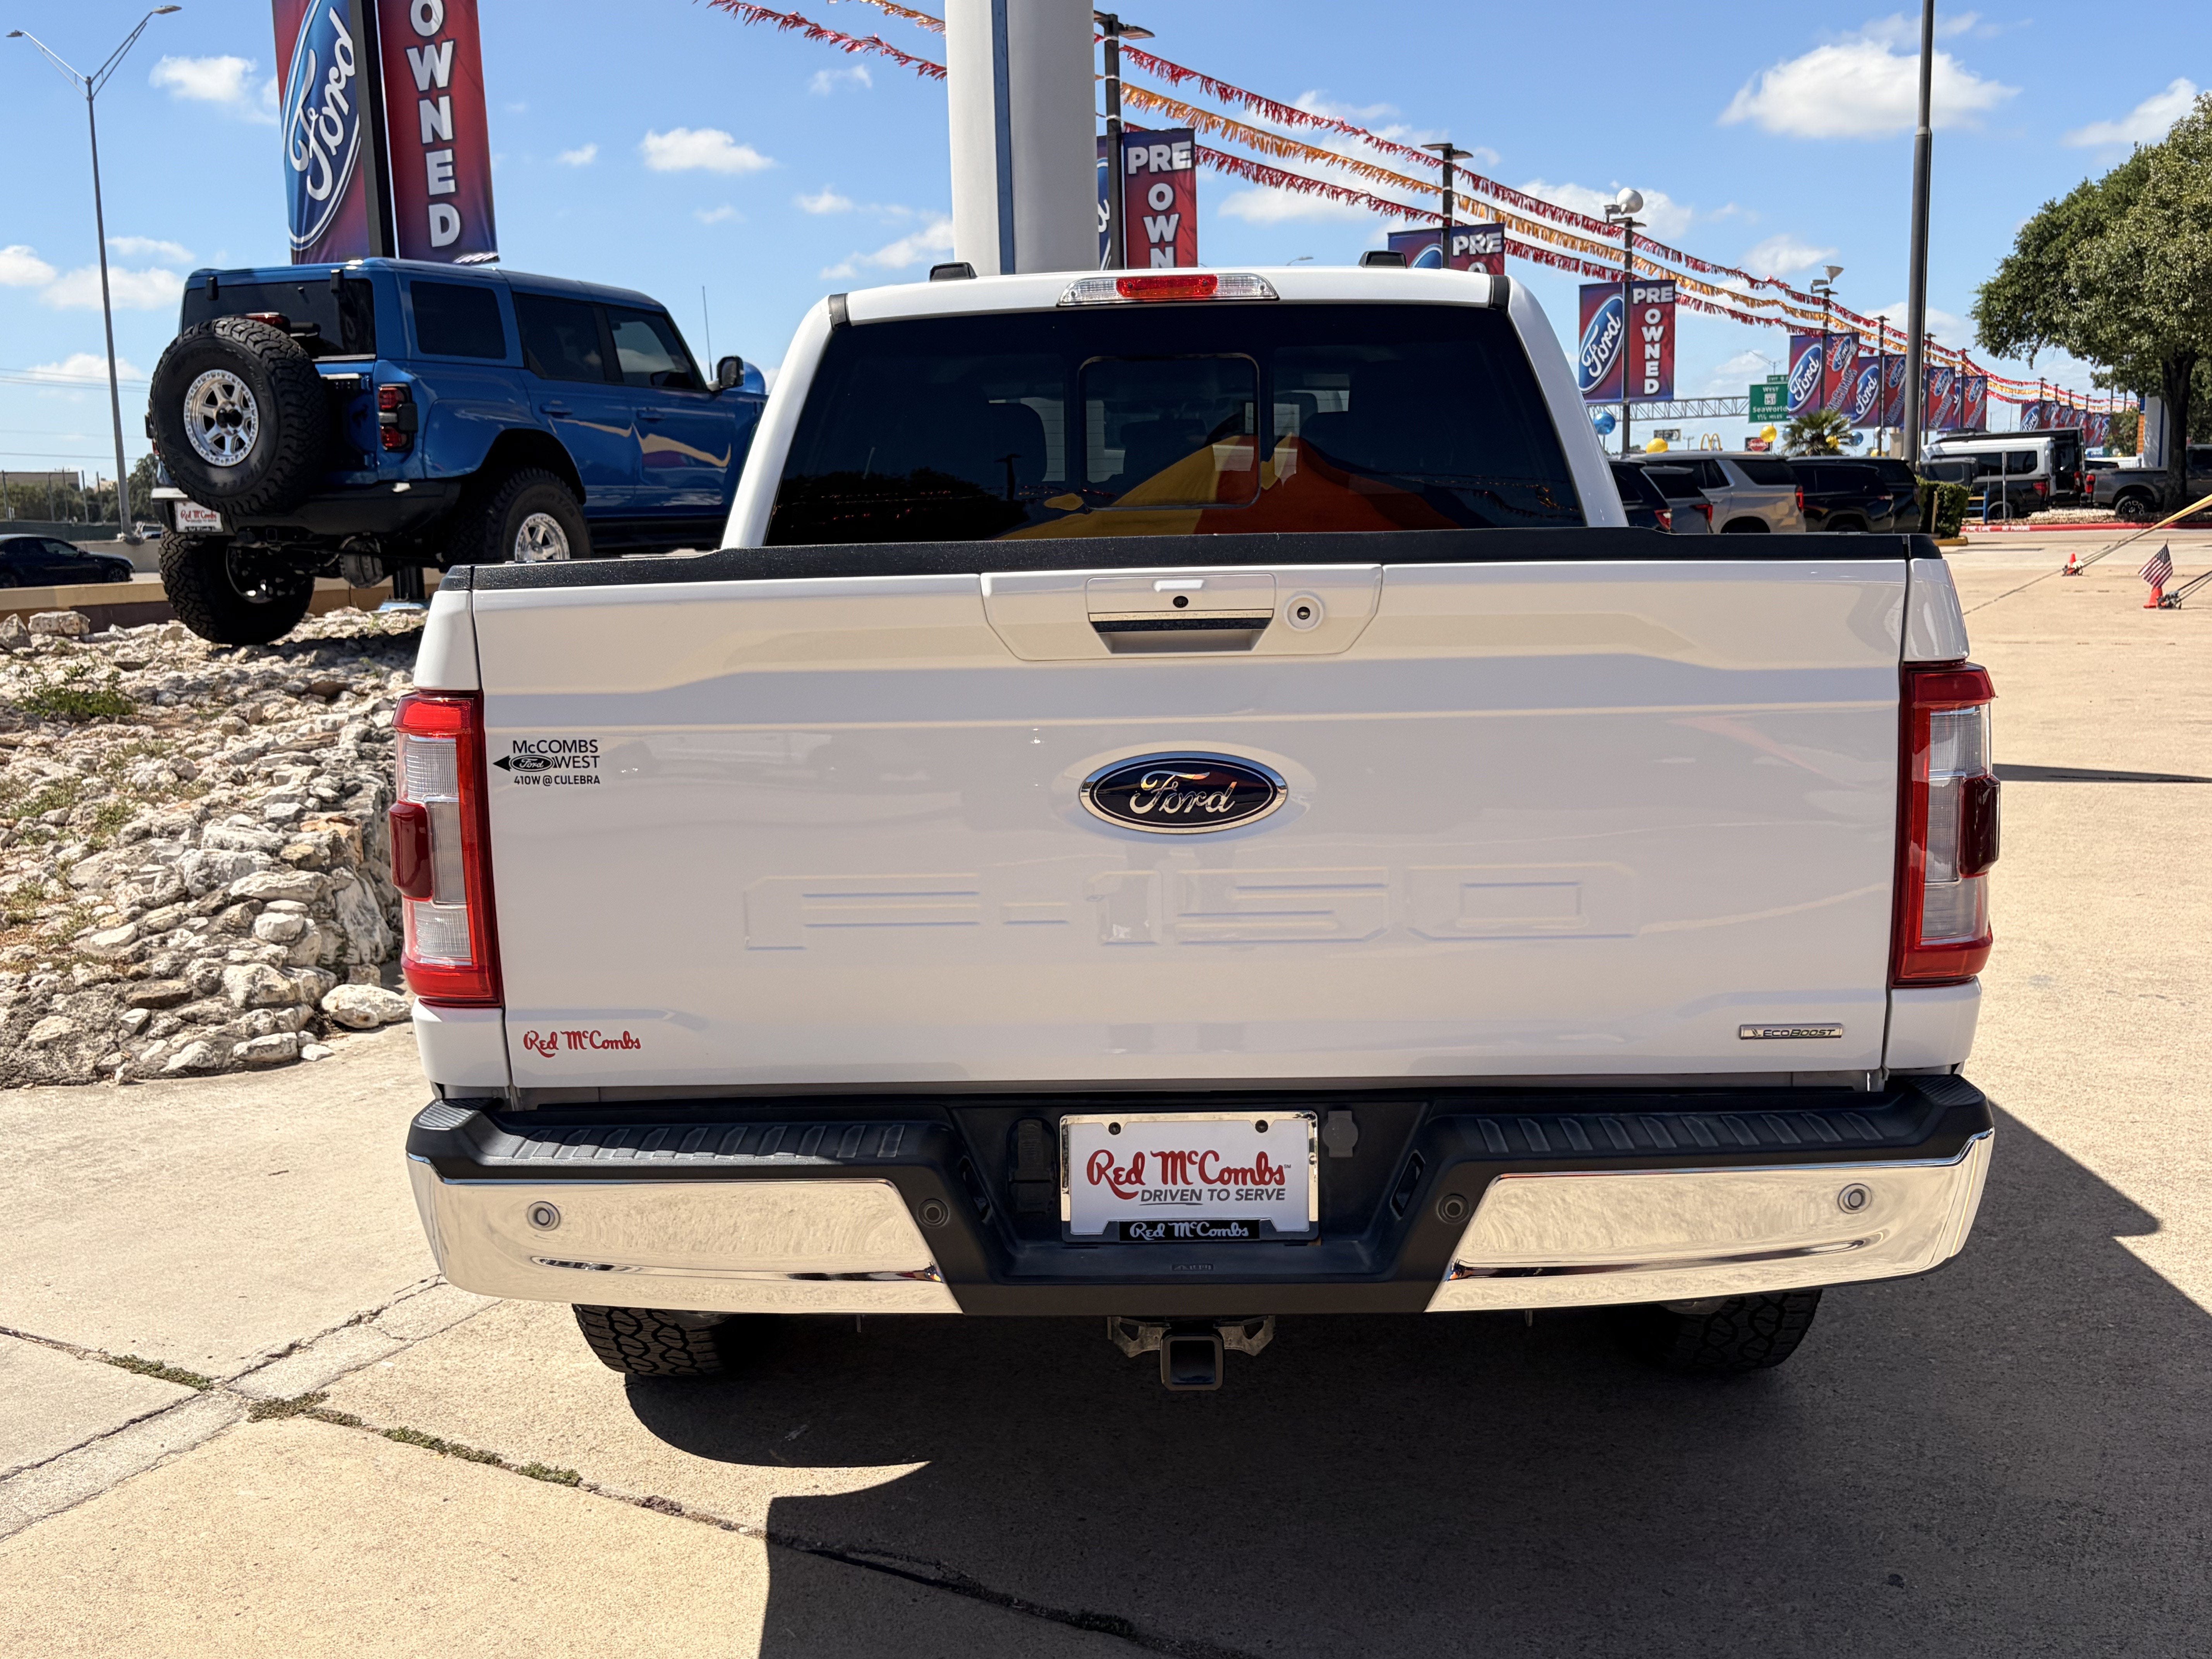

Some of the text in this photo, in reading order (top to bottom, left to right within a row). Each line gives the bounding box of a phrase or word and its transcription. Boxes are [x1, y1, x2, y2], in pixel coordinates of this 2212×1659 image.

[289, 7, 356, 201] Ford
[406, 0, 460, 247] OWNED
[1127, 141, 1192, 175] PRE
[1143, 183, 1180, 268] OWN
[1452, 232, 1503, 256] PRE
[1632, 286, 1674, 304] PRE
[1581, 311, 1621, 378] Ford
[1641, 308, 1664, 395] OWNED
[1790, 356, 1819, 402] Ford
[1856, 374, 1877, 415] Ford
[512, 739, 599, 754] McCOMBS
[519, 755, 600, 768] Ford WEST
[514, 775, 600, 787] 410W @ CULEBRA
[1129, 770, 1237, 814] Ford
[743, 862, 1640, 951] F-150
[523, 1030, 641, 1058] Red McCombs
[1086, 1149, 1146, 1200] Red
[1150, 1149, 1285, 1186] McCombs
[1141, 1188, 1286, 1202] DRIVEN TO SERVE
[1130, 1221, 1249, 1240] Red McCombs
